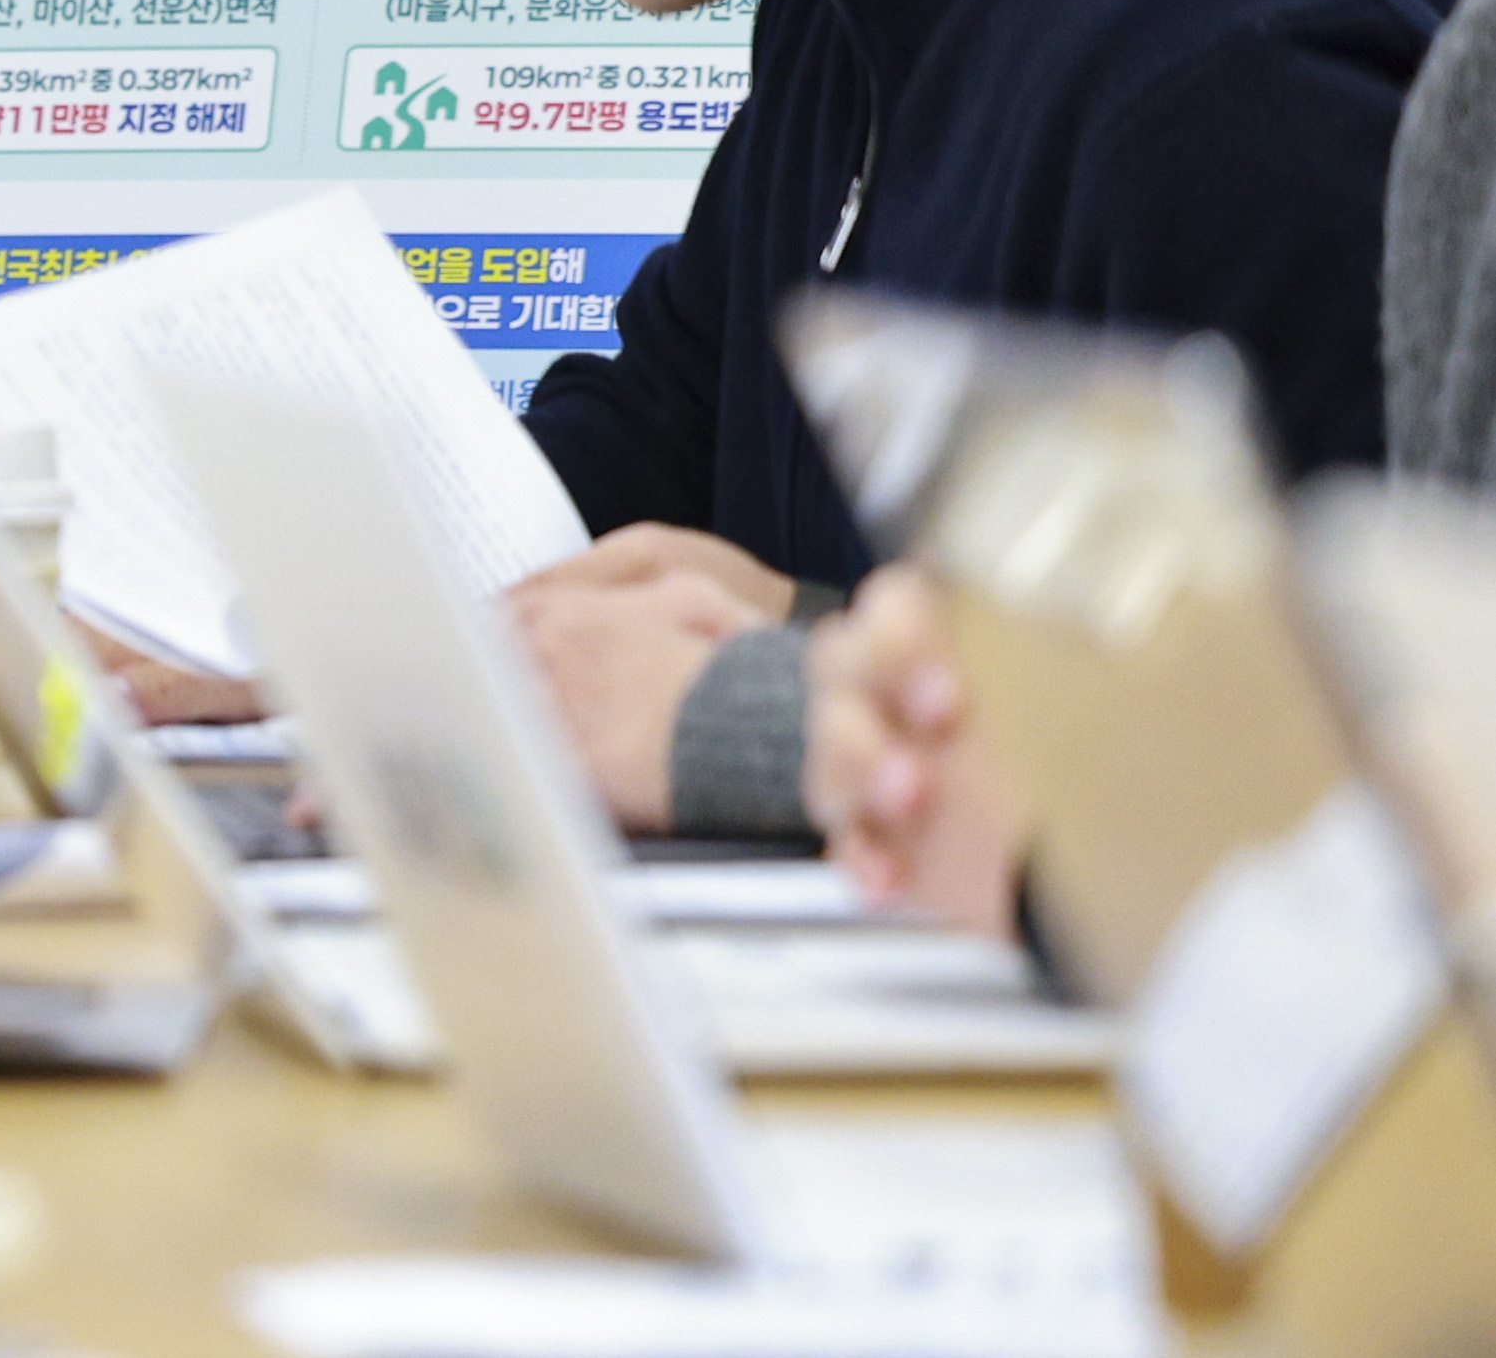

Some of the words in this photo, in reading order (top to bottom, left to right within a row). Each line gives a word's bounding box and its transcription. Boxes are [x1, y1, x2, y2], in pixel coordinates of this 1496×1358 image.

[626, 65, 752, 89] 0.321km
[117, 103, 177, 135] 지정
[186, 102, 247, 134] 해제
[474, 100, 627, 133] 약9.7만평
[479, 247, 587, 284] 도입해
[508, 294, 621, 332] 기대합
